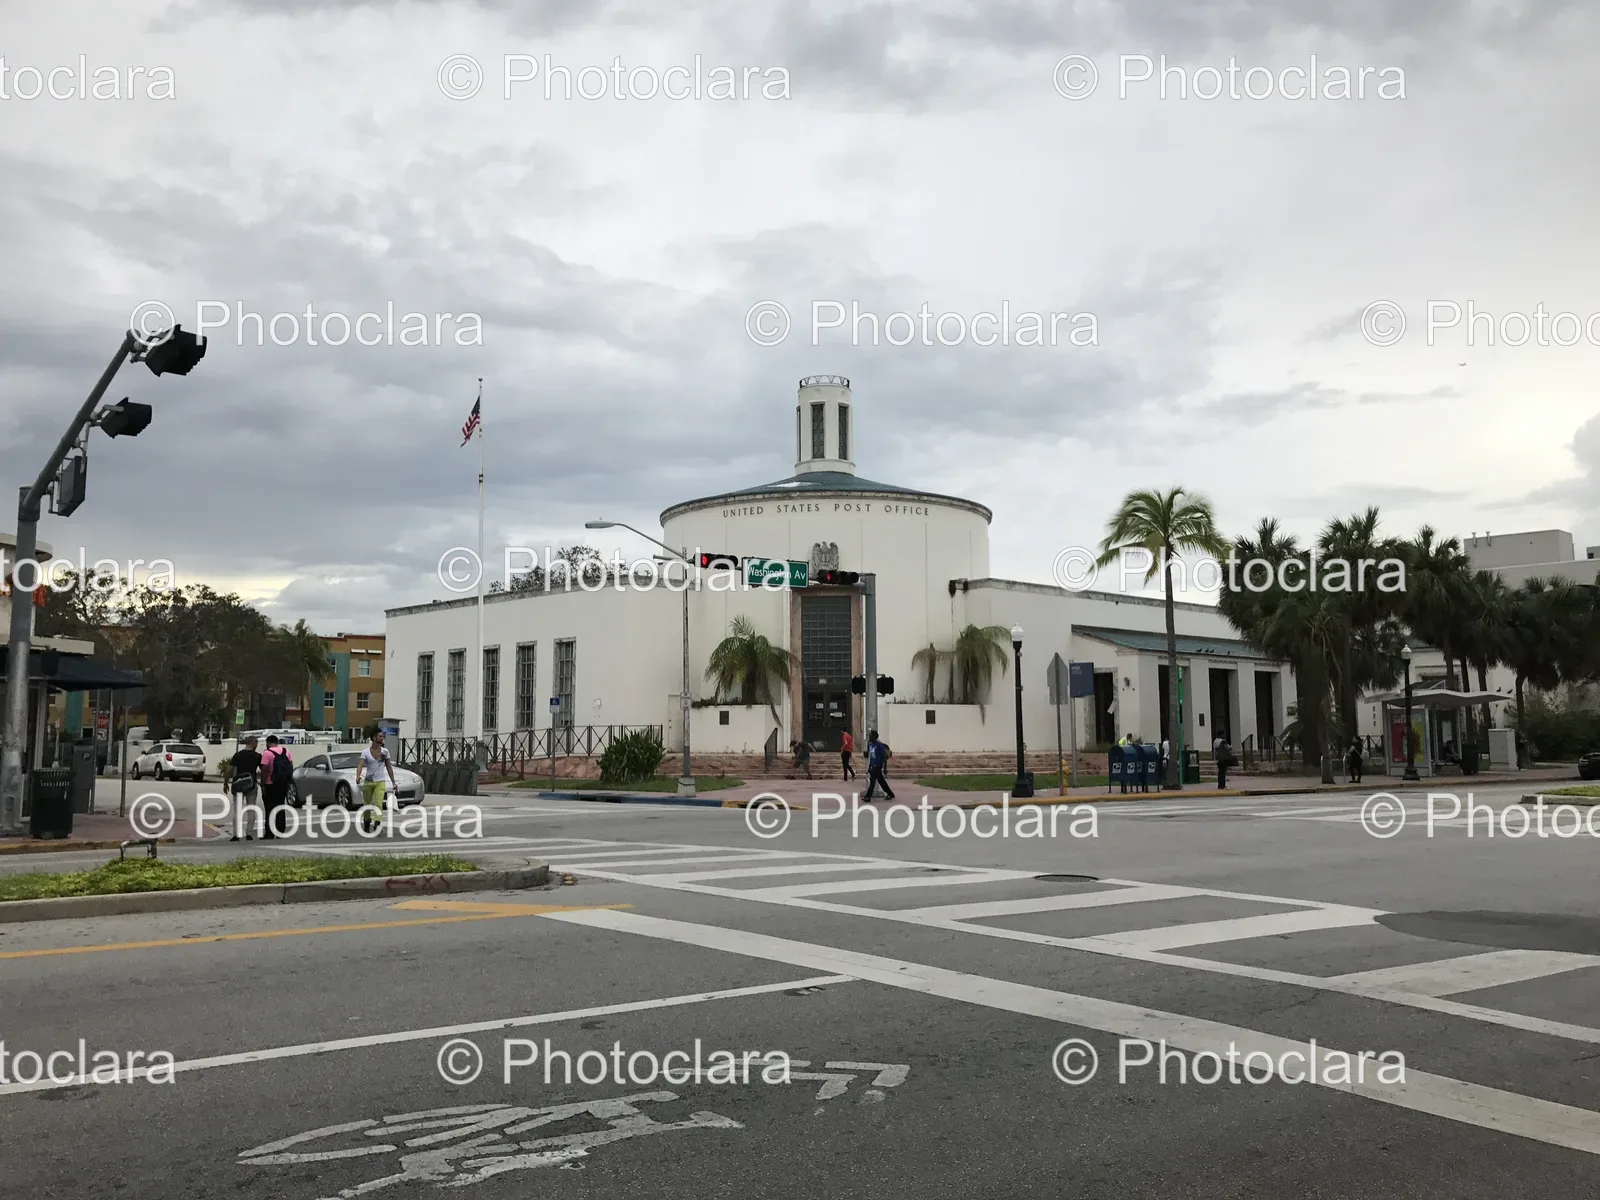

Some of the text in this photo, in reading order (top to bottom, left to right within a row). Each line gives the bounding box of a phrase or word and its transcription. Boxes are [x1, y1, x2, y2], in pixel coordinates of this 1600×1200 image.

[723, 503, 929, 518] UNITED STATES POST OFFICE
[748, 566, 806, 581] Washington Av
